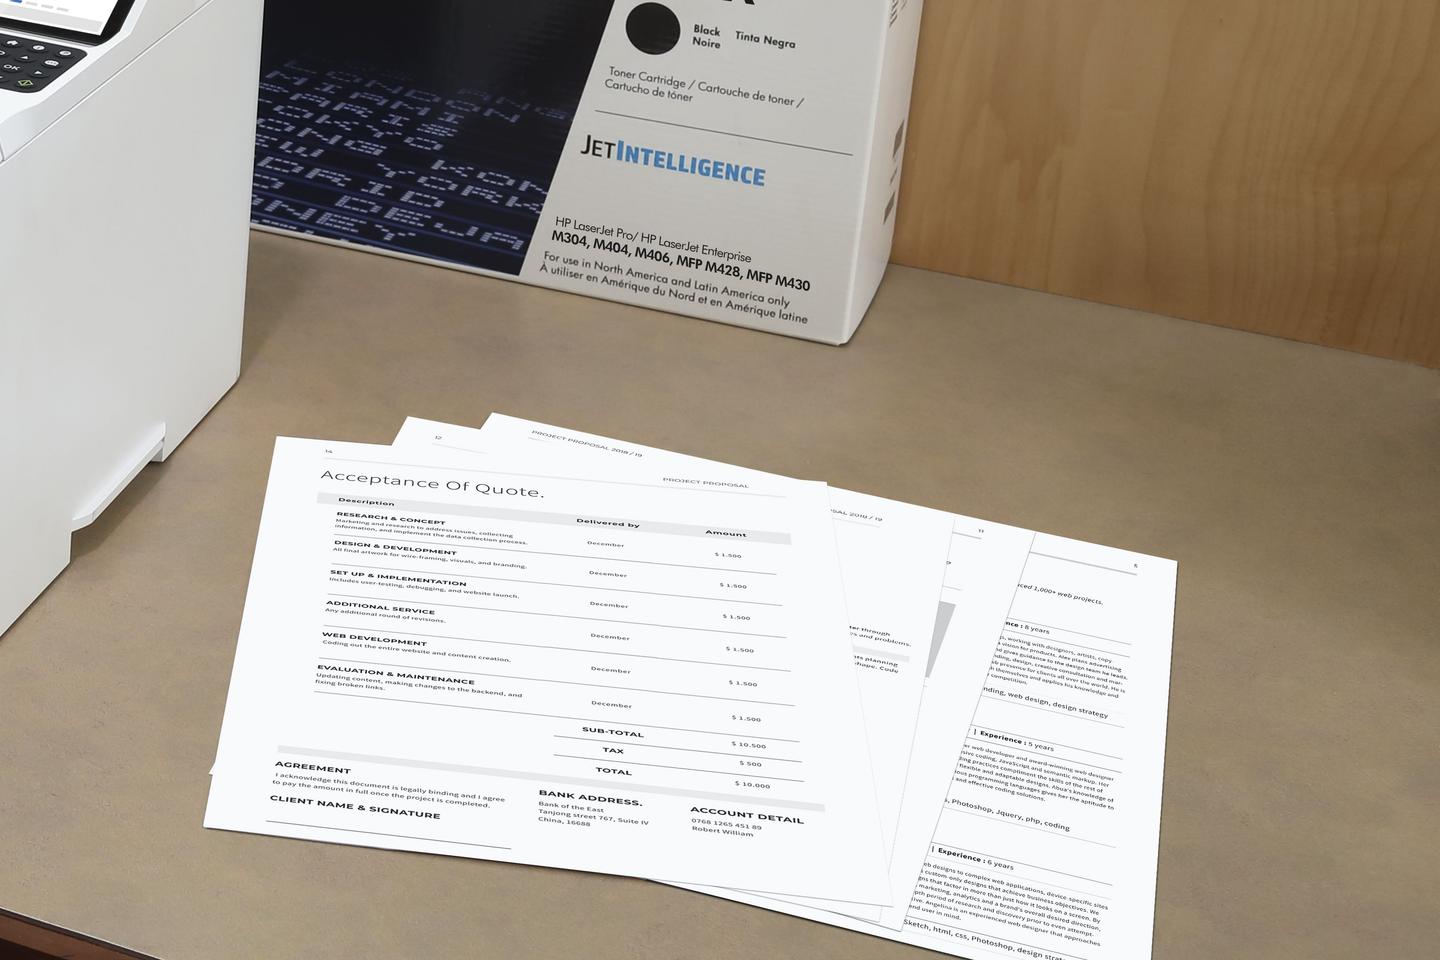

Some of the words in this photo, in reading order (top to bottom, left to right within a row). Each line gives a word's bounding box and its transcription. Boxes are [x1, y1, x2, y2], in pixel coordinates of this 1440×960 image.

[693, 23, 721, 39] Black
[692, 36, 721, 49] Noire
[735, 30, 761, 43] Tinta
[763, 35, 796, 50] Negra
[604, 78, 650, 95] Cartucho
[651, 86, 666, 98] de
[667, 87, 694, 102] tóner
[609, 66, 637, 79] Toner
[637, 71, 687, 92] Cartridge
[697, 81, 751, 99] Cartouche
[751, 90, 766, 102] de
[767, 93, 795, 106] toner
[555, 216, 571, 228] HP
[574, 219, 613, 237] LaserJet
[640, 232, 657, 245] HP
[658, 235, 700, 253] LaserJet
[701, 244, 752, 264] Enterprise
[551, 229, 591, 250] M304,
[592, 238, 632, 258] M404,
[634, 246, 674, 267] M406,
[676, 254, 703, 270] MFP
[704, 260, 744, 281] M428,
[746, 268, 773, 284] MFP
[774, 274, 811, 292] M430
[544, 251, 560, 262] For
[562, 256, 579, 266] use
[582, 257, 591, 268] in
[594, 261, 623, 275] North
[626, 268, 668, 284] America
[671, 276, 691, 288] and
[694, 280, 718, 295] Latin
[720, 285, 765, 302] America
[767, 295, 791, 310] only
[539, 262, 548, 273] À
[550, 266, 584, 280] utiliser
[585, 274, 599, 283] en
[600, 275, 651, 294] Amérique
[652, 285, 666, 297] du
[668, 287, 696, 303] Nord
[697, 295, 708, 305] et
[709, 298, 723, 308] en
[724, 299, 777, 319] Amérique
[778, 306, 809, 325] latine
[320, 470, 440, 489] Acceptance
[446, 480, 470, 492] Of
[475, 483, 544, 499] Quote.
[338, 497, 395, 507] Description
[336, 511, 388, 521] RESEARCH
[399, 517, 446, 526] CONCEPT
[576, 518, 625, 527] Delivered
[705, 529, 746, 538] Amount
[334, 540, 371, 548] DESIGN
[382, 544, 457, 556] DEVELOPMENT
[377, 574, 467, 587] IMPLEMENTATION
[1057, 591, 1073, 599] web
[1072, 595, 1104, 606] projects.
[326, 600, 390, 611] ADDITIONAL
[392, 606, 435, 616] SERVICE
[322, 631, 347, 639] WEB
[349, 634, 427, 647] DEVELOPMENT
[317, 664, 384, 676] EVALUATION
[396, 672, 475, 686] MAINTENANCE
[591, 700, 632, 709] December
[1007, 692, 1024, 700] web
[1024, 695, 1051, 707] design,
[1052, 701, 1077, 712] design
[1078, 708, 1109, 720] strategy
[582, 726, 645, 738] SUB-TOTAL
[980, 730, 1023, 745] Experience
[1034, 739, 1055, 752] years
[602, 747, 624, 755] TAX
[274, 761, 352, 775] AGREEMENT
[595, 766, 632, 776] TOTAL
[538, 789, 575, 800] BANK
[578, 794, 643, 807] ADDRESS.
[269, 794, 314, 805] CLIENT
[317, 800, 354, 810] NAME
[369, 806, 441, 820] SIGNATURE
[690, 806, 754, 819] ACCOUNT
[757, 813, 805, 825] DETAIL
[951, 798, 995, 814] Photoshop,
[995, 809, 1024, 821] Jquery,
[1025, 816, 1043, 826] php,
[1043, 821, 1071, 833] coding
[691, 825, 721, 834] Robert
[721, 829, 754, 838] William
[937, 847, 982, 863] Experience
[993, 860, 1014, 871] years
[932, 925, 954, 937] html,
